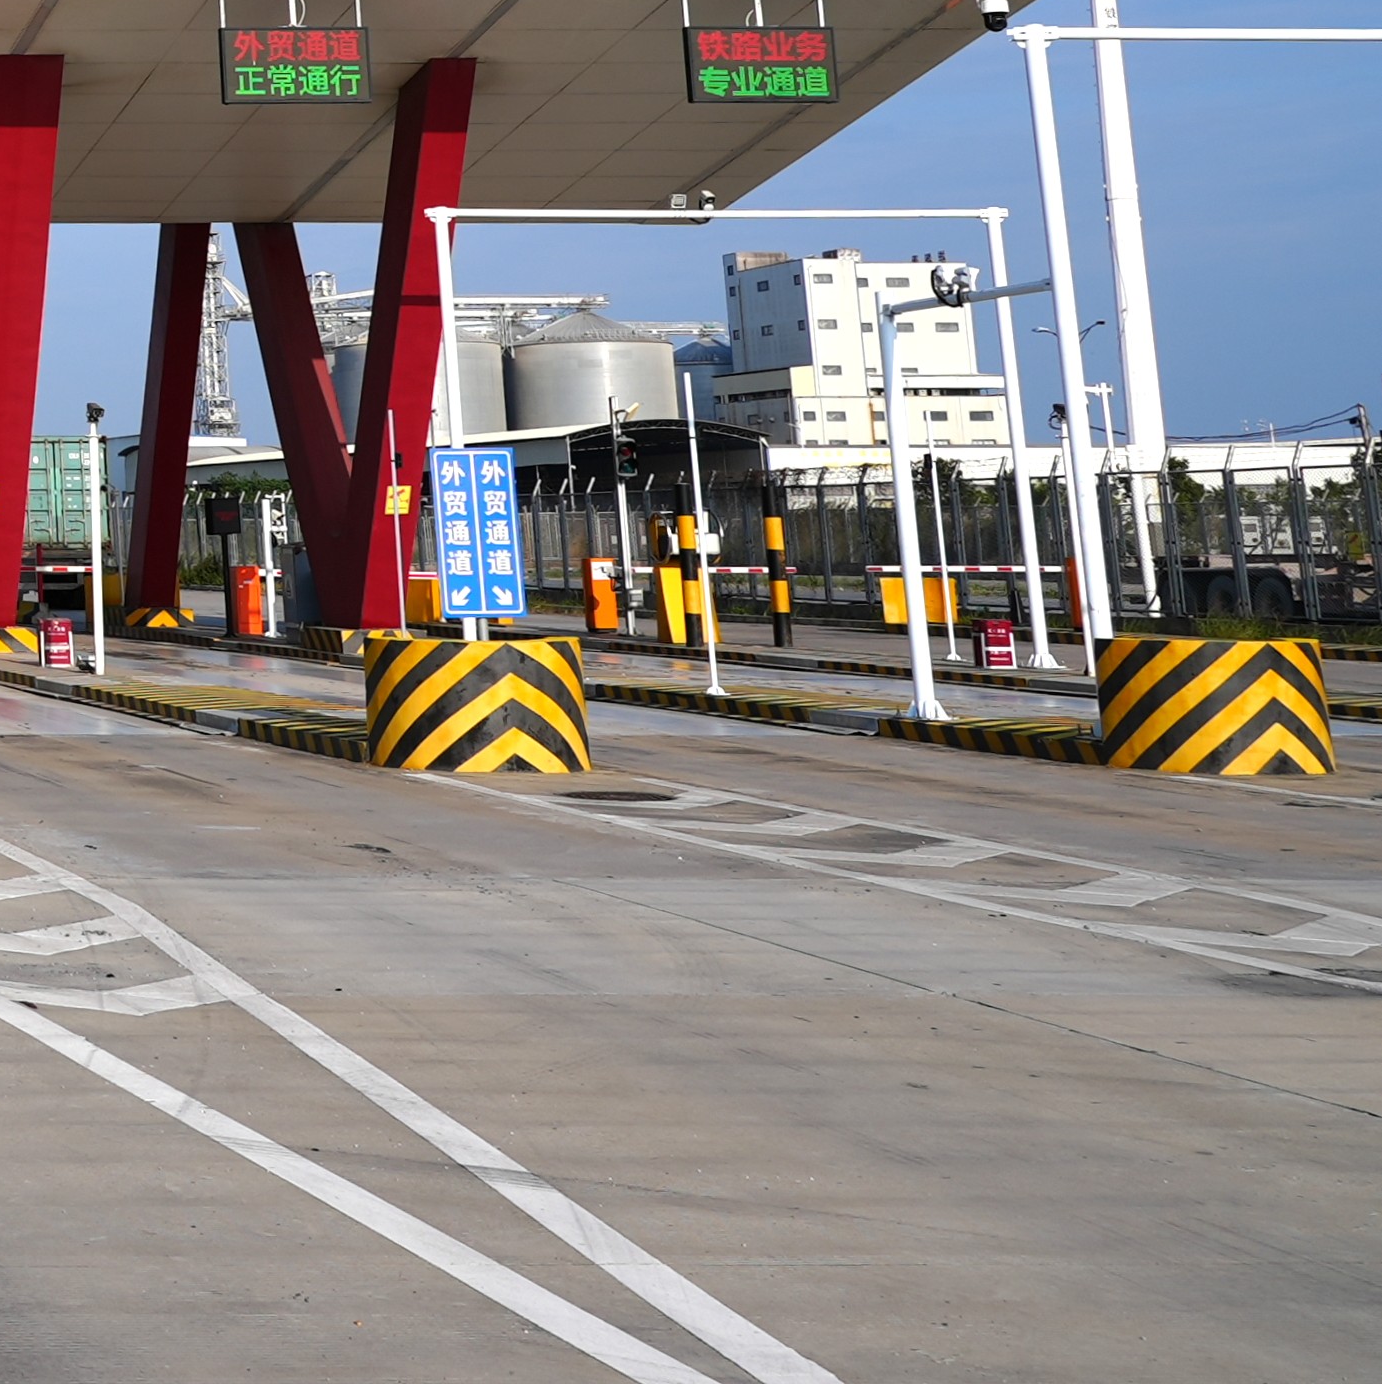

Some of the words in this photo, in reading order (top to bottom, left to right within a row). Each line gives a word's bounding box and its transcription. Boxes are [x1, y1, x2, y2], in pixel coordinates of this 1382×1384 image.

[233, 30, 362, 62] 外贸通道
[697, 30, 827, 62] 铁路业务
[234, 64, 361, 97] 正常通行
[698, 66, 830, 97] 专业通道
[440, 460, 474, 576] 外贸通道
[480, 460, 514, 576] 外贸通道
